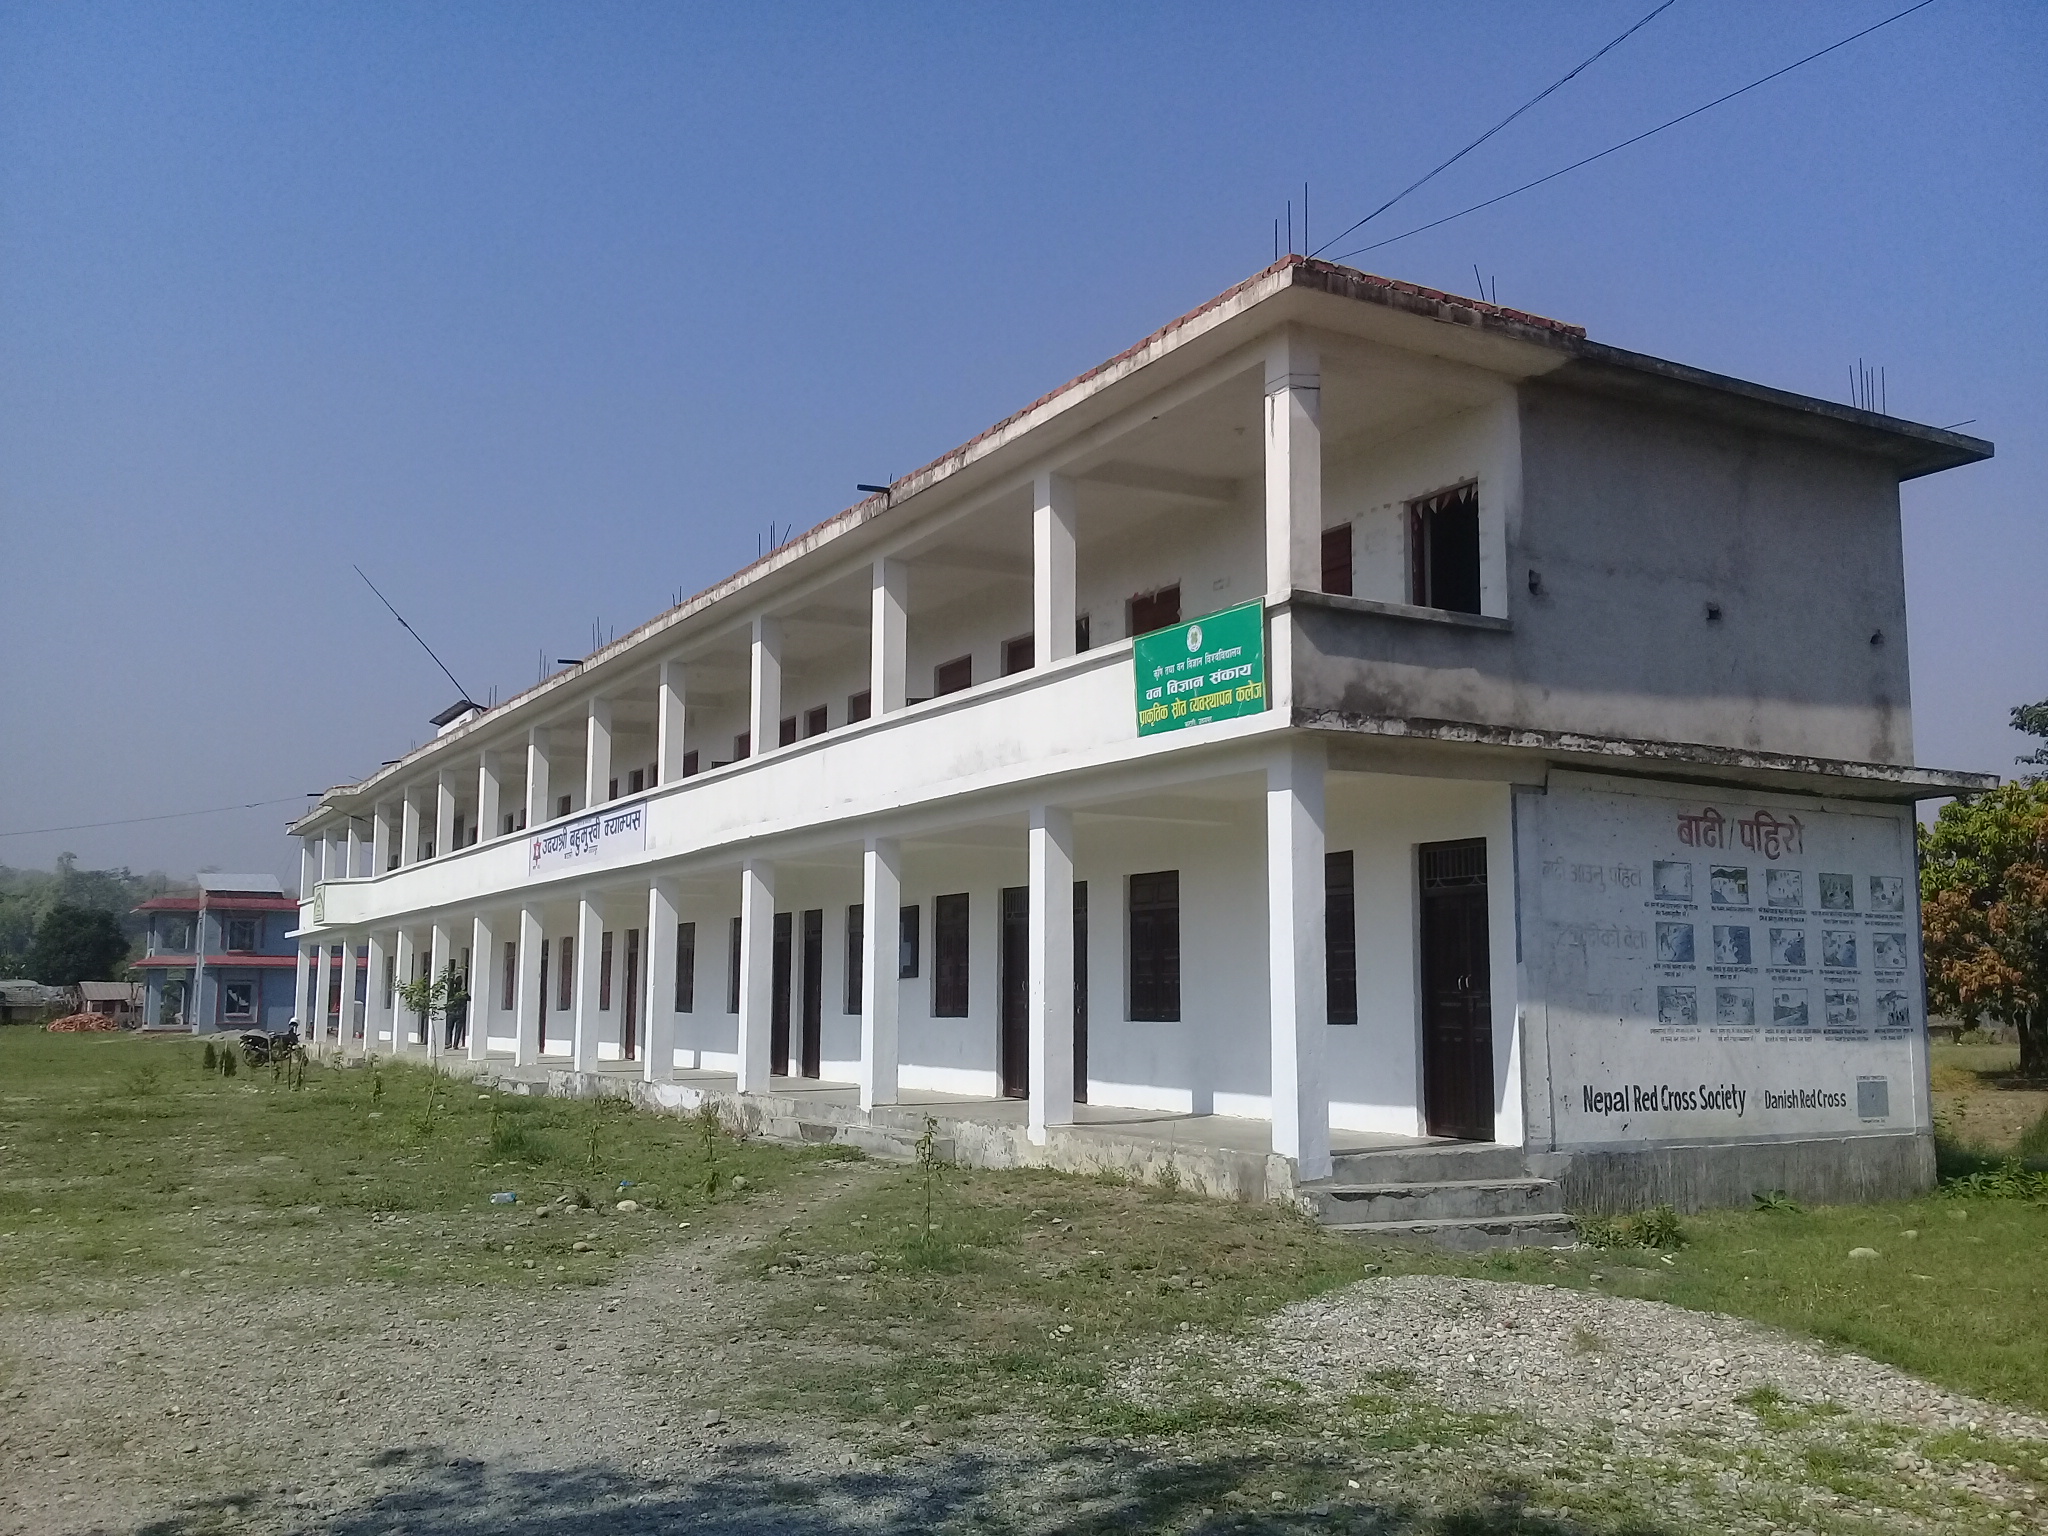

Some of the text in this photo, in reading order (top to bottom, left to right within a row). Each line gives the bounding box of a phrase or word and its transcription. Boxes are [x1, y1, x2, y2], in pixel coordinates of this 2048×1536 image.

[1146, 663, 1253, 700] वन विज्ञान संकाय
[1176, 661, 1185, 671] वन
[1139, 702, 1169, 727] प्राकृतिक
[1189, 689, 1233, 712] व्यवस्थापन
[1235, 679, 1263, 702] कलेज
[569, 816, 601, 857] बहुमुखी
[603, 810, 642, 837] क्याम्पस
[1582, 1083, 1747, 1118] Nepal Red Cross Society
[1764, 1088, 1847, 1109] Danish Red Cross
